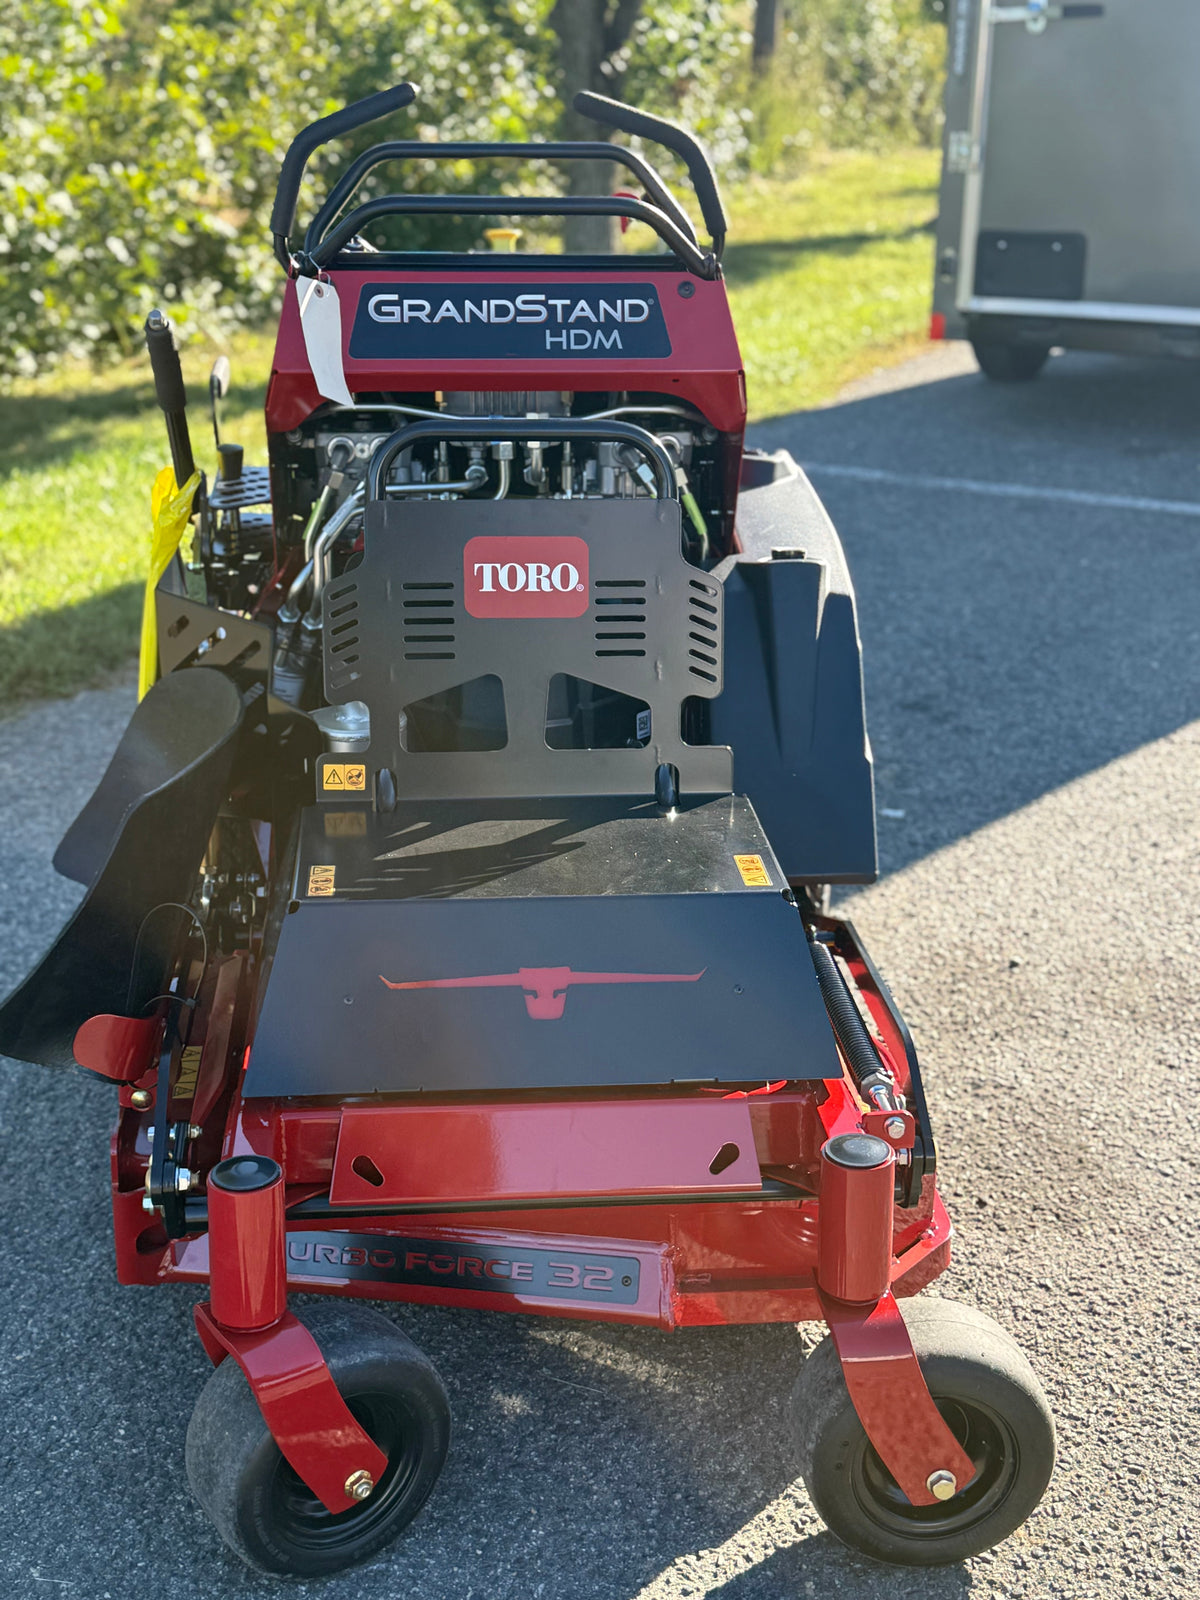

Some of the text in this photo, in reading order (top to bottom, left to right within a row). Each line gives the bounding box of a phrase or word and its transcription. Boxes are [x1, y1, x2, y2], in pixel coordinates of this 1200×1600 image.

[367, 294, 649, 323] GRANDSTAND
[545, 329, 623, 350] HDM
[474, 562, 579, 593] TORO
[288, 1241, 614, 1291] URBO FORCE 32
